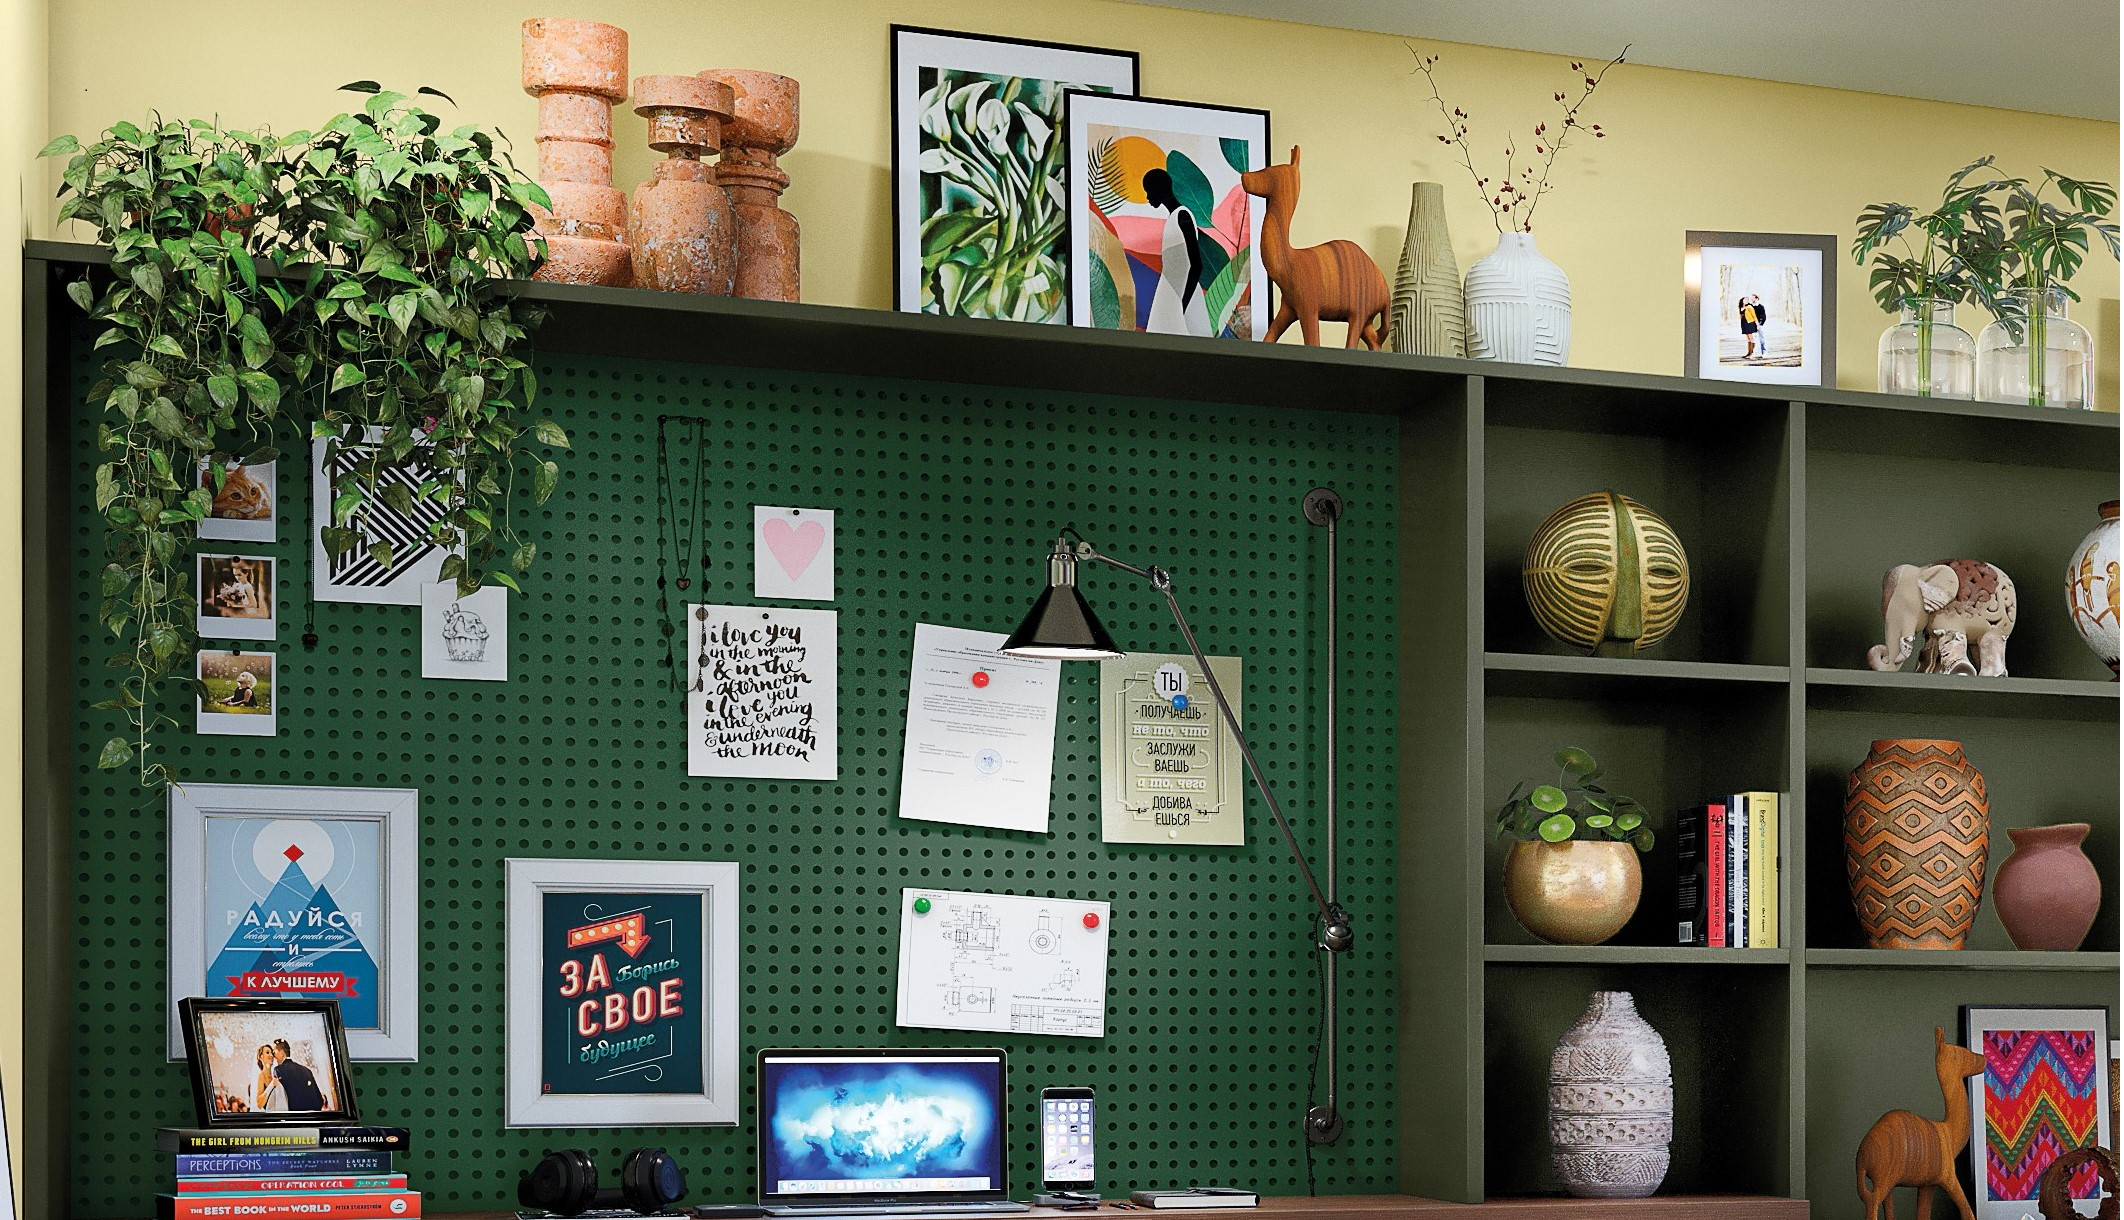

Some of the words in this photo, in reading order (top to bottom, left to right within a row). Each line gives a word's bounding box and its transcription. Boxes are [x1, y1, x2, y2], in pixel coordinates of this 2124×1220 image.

[721, 621, 763, 647] love
[765, 623, 801, 647] you
[709, 644, 725, 660] in
[728, 645, 755, 660] the
[757, 642, 806, 662] morning
[713, 659, 733, 680] &
[735, 659, 761, 677] in
[760, 655, 801, 675] the
[716, 672, 812, 703] afternoon
[1160, 671, 1183, 692] ТЫ
[719, 695, 764, 719] love
[767, 686, 799, 708] you
[703, 714, 724, 731] in
[725, 716, 754, 729] the
[755, 701, 819, 726] evening
[1141, 704, 1201, 720] ПОЛУЧАЕШЬ
[705, 731, 717, 747] &
[718, 725, 818, 750] underneath
[1132, 724, 1150, 737] не
[1179, 726, 1210, 738] что
[711, 744, 749, 759] the
[751, 742, 810, 762] moon
[1147, 741, 1196, 757] ЗАСЛУЖИ
[1154, 758, 1190, 773] ВАЕШЬ
[1177, 779, 1207, 790] чего
[1152, 795, 1192, 811] ДОБИВА
[1155, 812, 1191, 826] ЕШЬСЯ
[226, 907, 363, 929] РАДУЙСЯ
[288, 944, 299, 955] И
[247, 976, 257, 988] К
[260, 976, 340, 989] ЛУЧШЕМУ
[560, 952, 612, 998] ЗА
[616, 958, 680, 982] Борись
[577, 977, 684, 1038] СВОЕ
[580, 1033, 657, 1065] будущее
[190, 1137, 206, 1147] THE
[208, 1137, 227, 1146] GIRL
[229, 1136, 251, 1146] FROM
[293, 1135, 317, 1145] HILLS
[322, 1136, 355, 1144] ANKUSH
[260, 1180, 317, 1190] OPERATION
[320, 1180, 345, 1188] COOL
[204, 1206, 231, 1216] BEST
[234, 1205, 267, 1215] BOOK
[290, 1203, 331, 1213] WORLD
